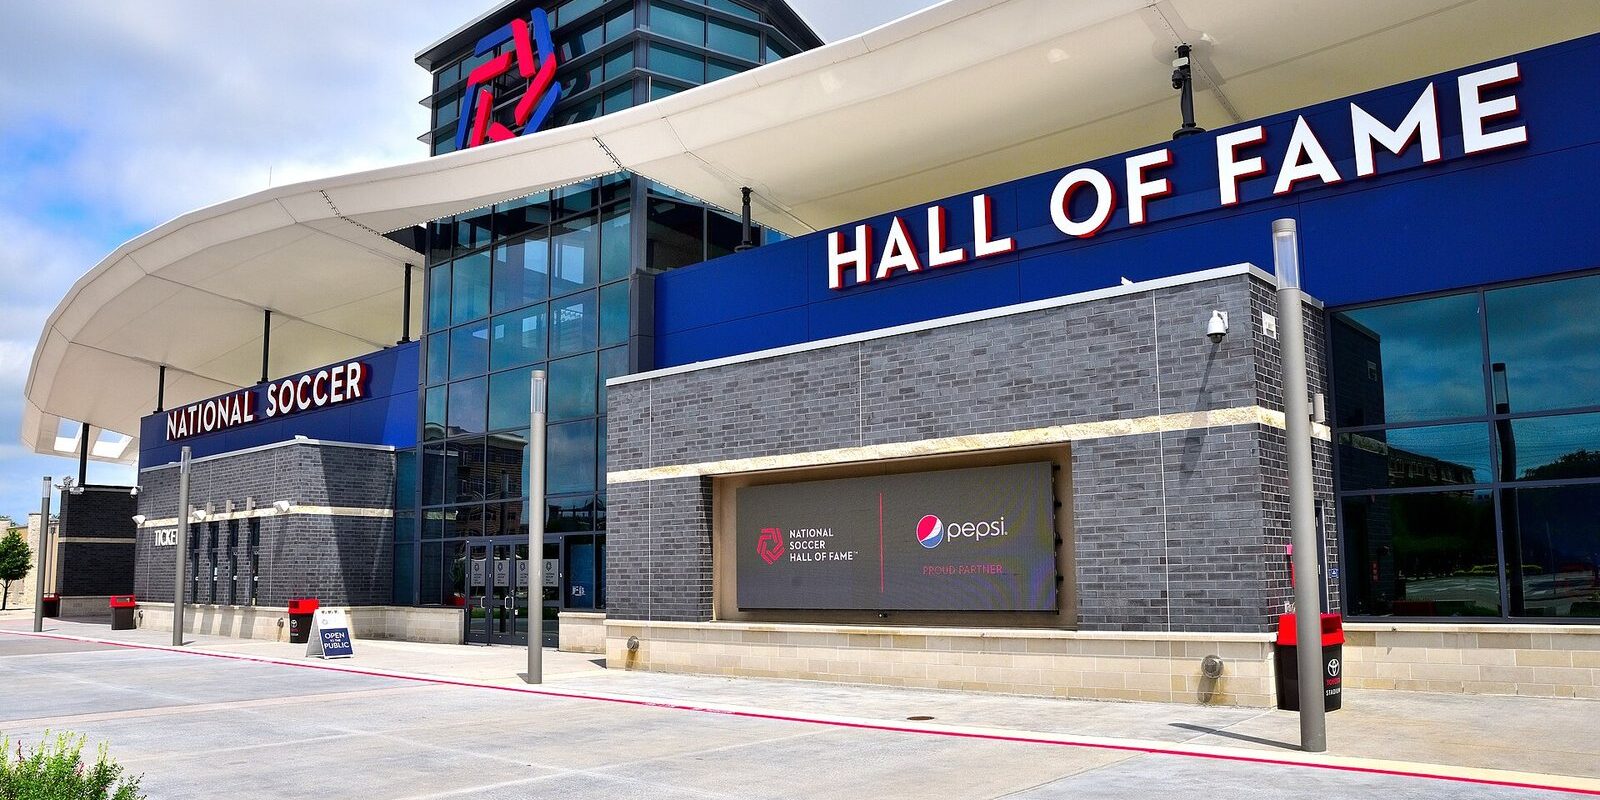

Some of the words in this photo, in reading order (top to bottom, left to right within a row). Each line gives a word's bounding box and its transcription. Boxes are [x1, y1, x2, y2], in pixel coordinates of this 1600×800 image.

[827, 193, 1015, 290] HALL
[1049, 148, 1173, 240] OF
[1216, 62, 1529, 206] FAME
[166, 391, 255, 441] NATIONAL
[266, 361, 365, 417] SOCCER
[789, 528, 834, 538] NATIONAL
[789, 540, 826, 550] SOCCER
[790, 552, 812, 562] HALL
[814, 552, 827, 561] OF
[922, 565, 956, 575] PROUD
[959, 564, 1003, 574] PARTNER
[324, 632, 345, 640] OPEN
